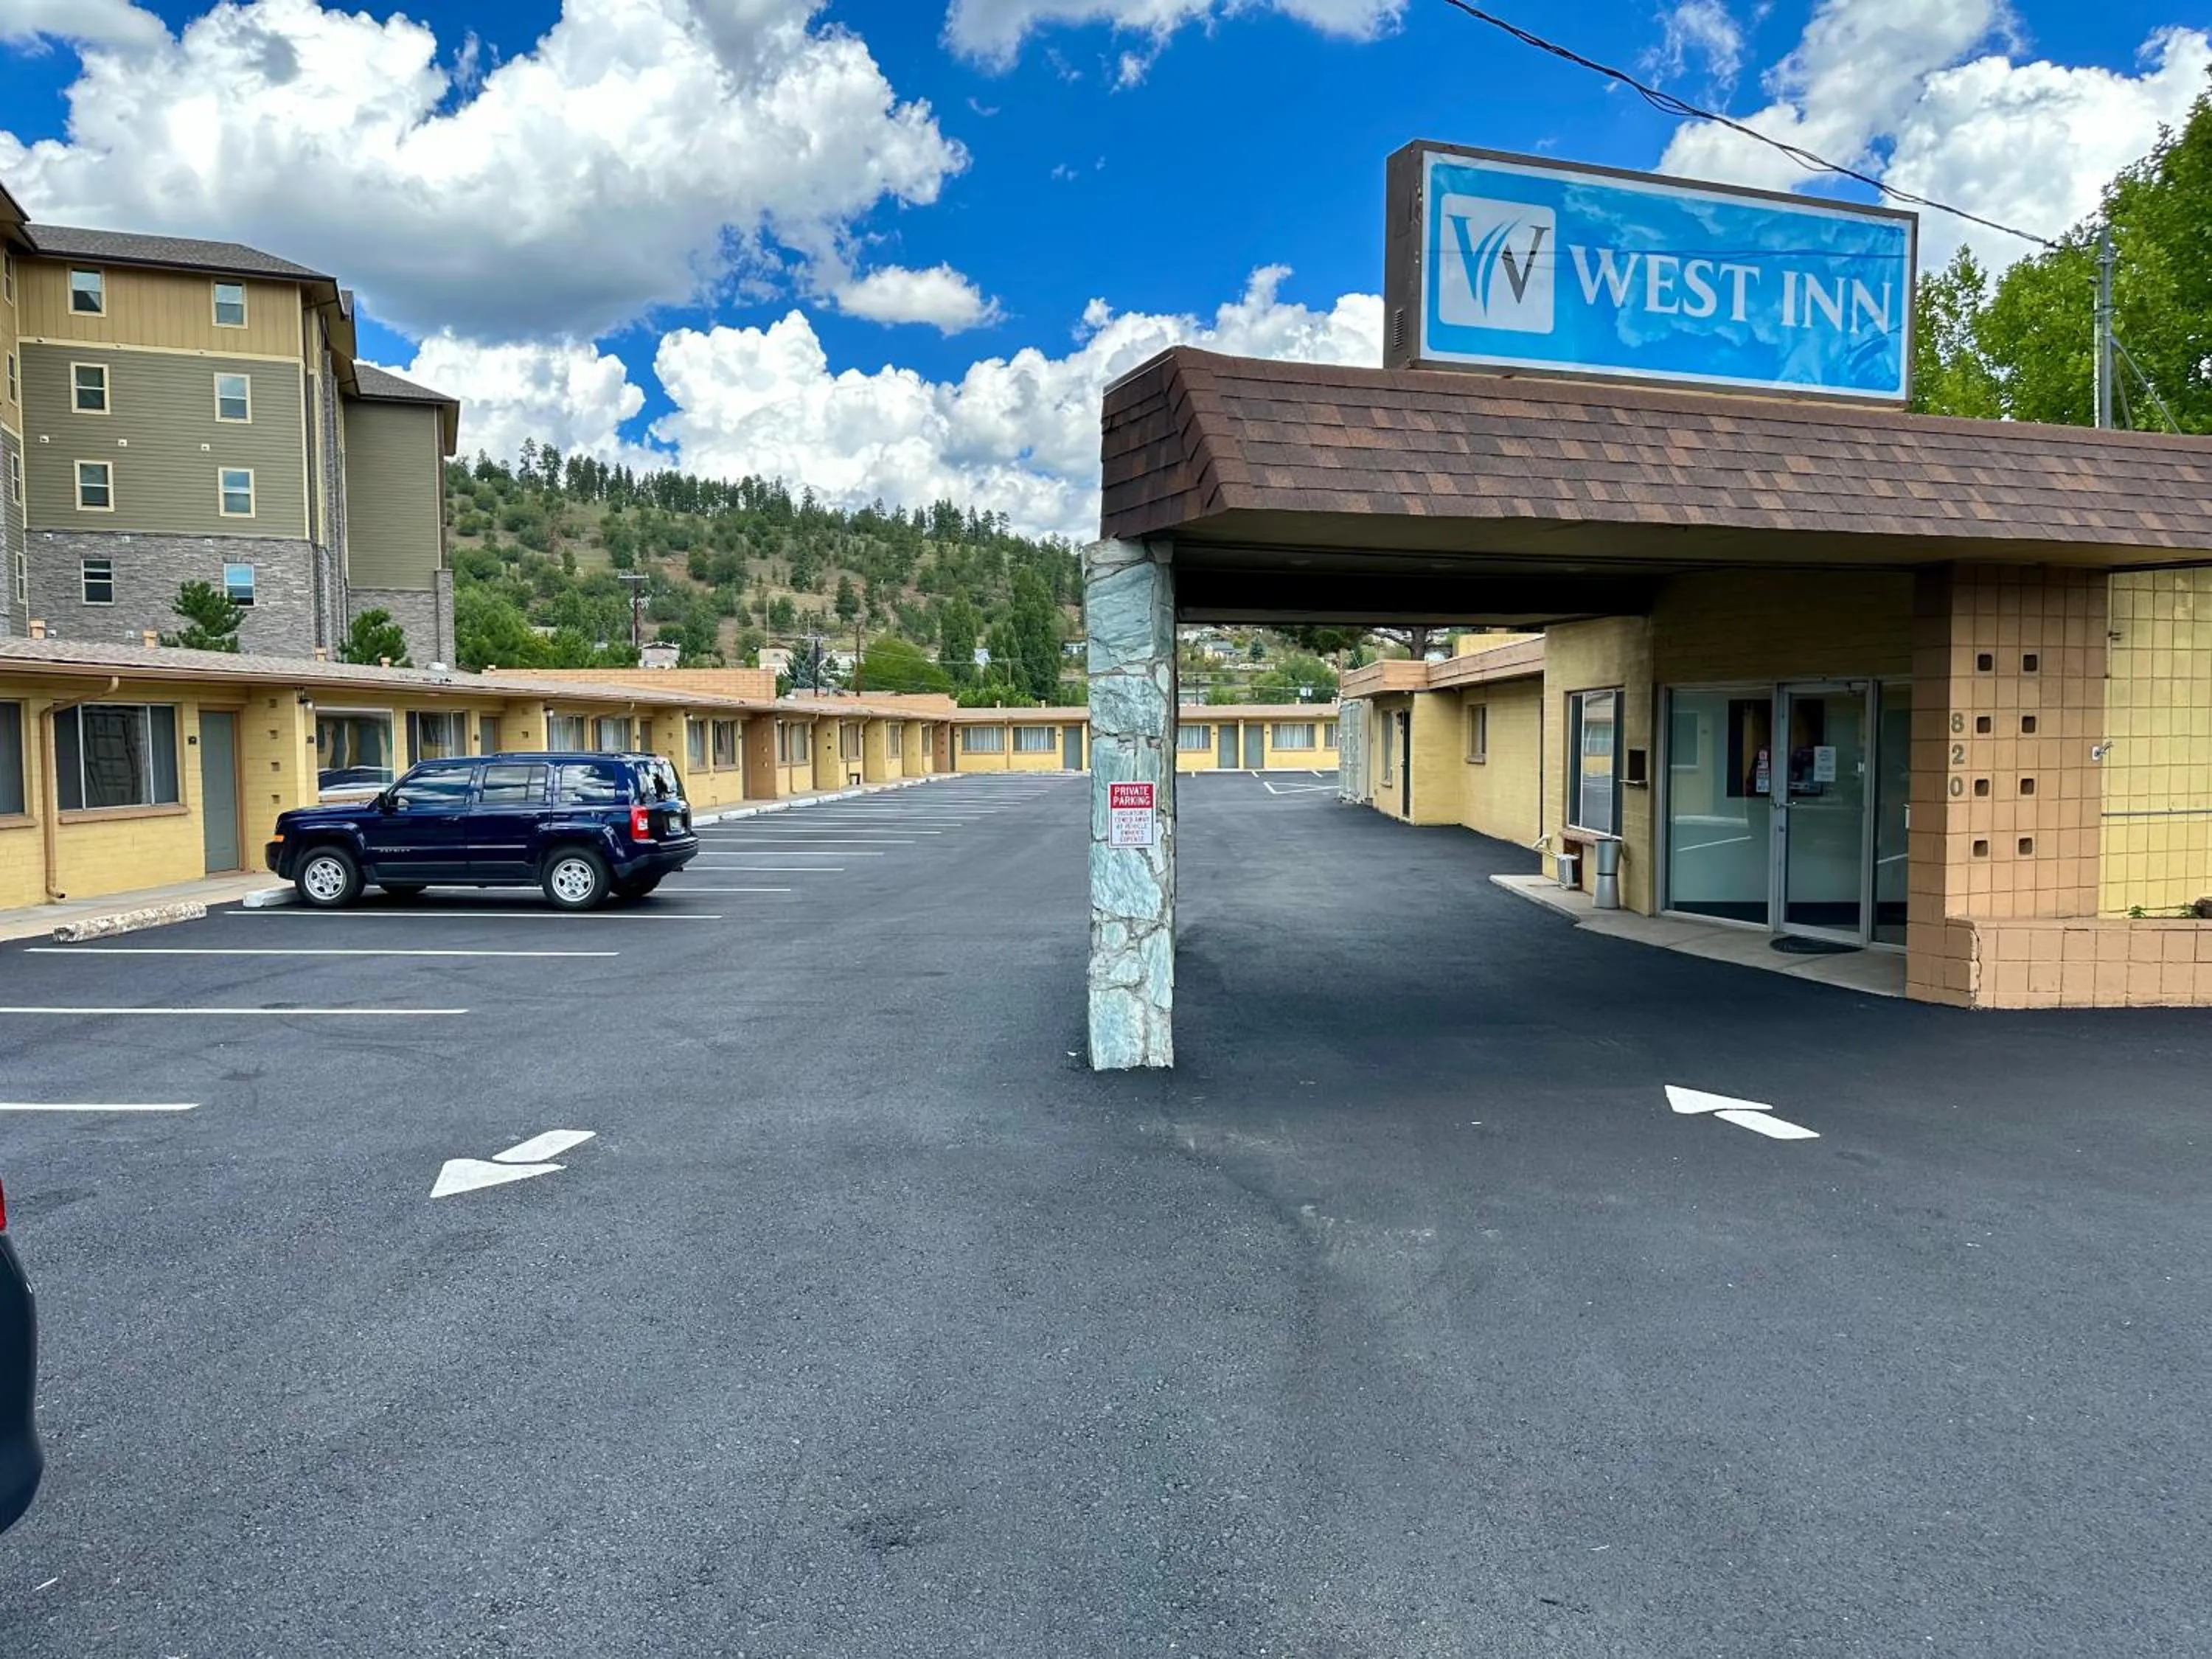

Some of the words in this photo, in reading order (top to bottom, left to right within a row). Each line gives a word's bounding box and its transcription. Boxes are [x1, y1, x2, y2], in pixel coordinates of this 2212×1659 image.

[1568, 243, 1761, 322] WEST
[1780, 271, 1893, 335] INN
[1114, 786, 1150, 796] PRIVATE
[1113, 796, 1151, 806] PARKING
